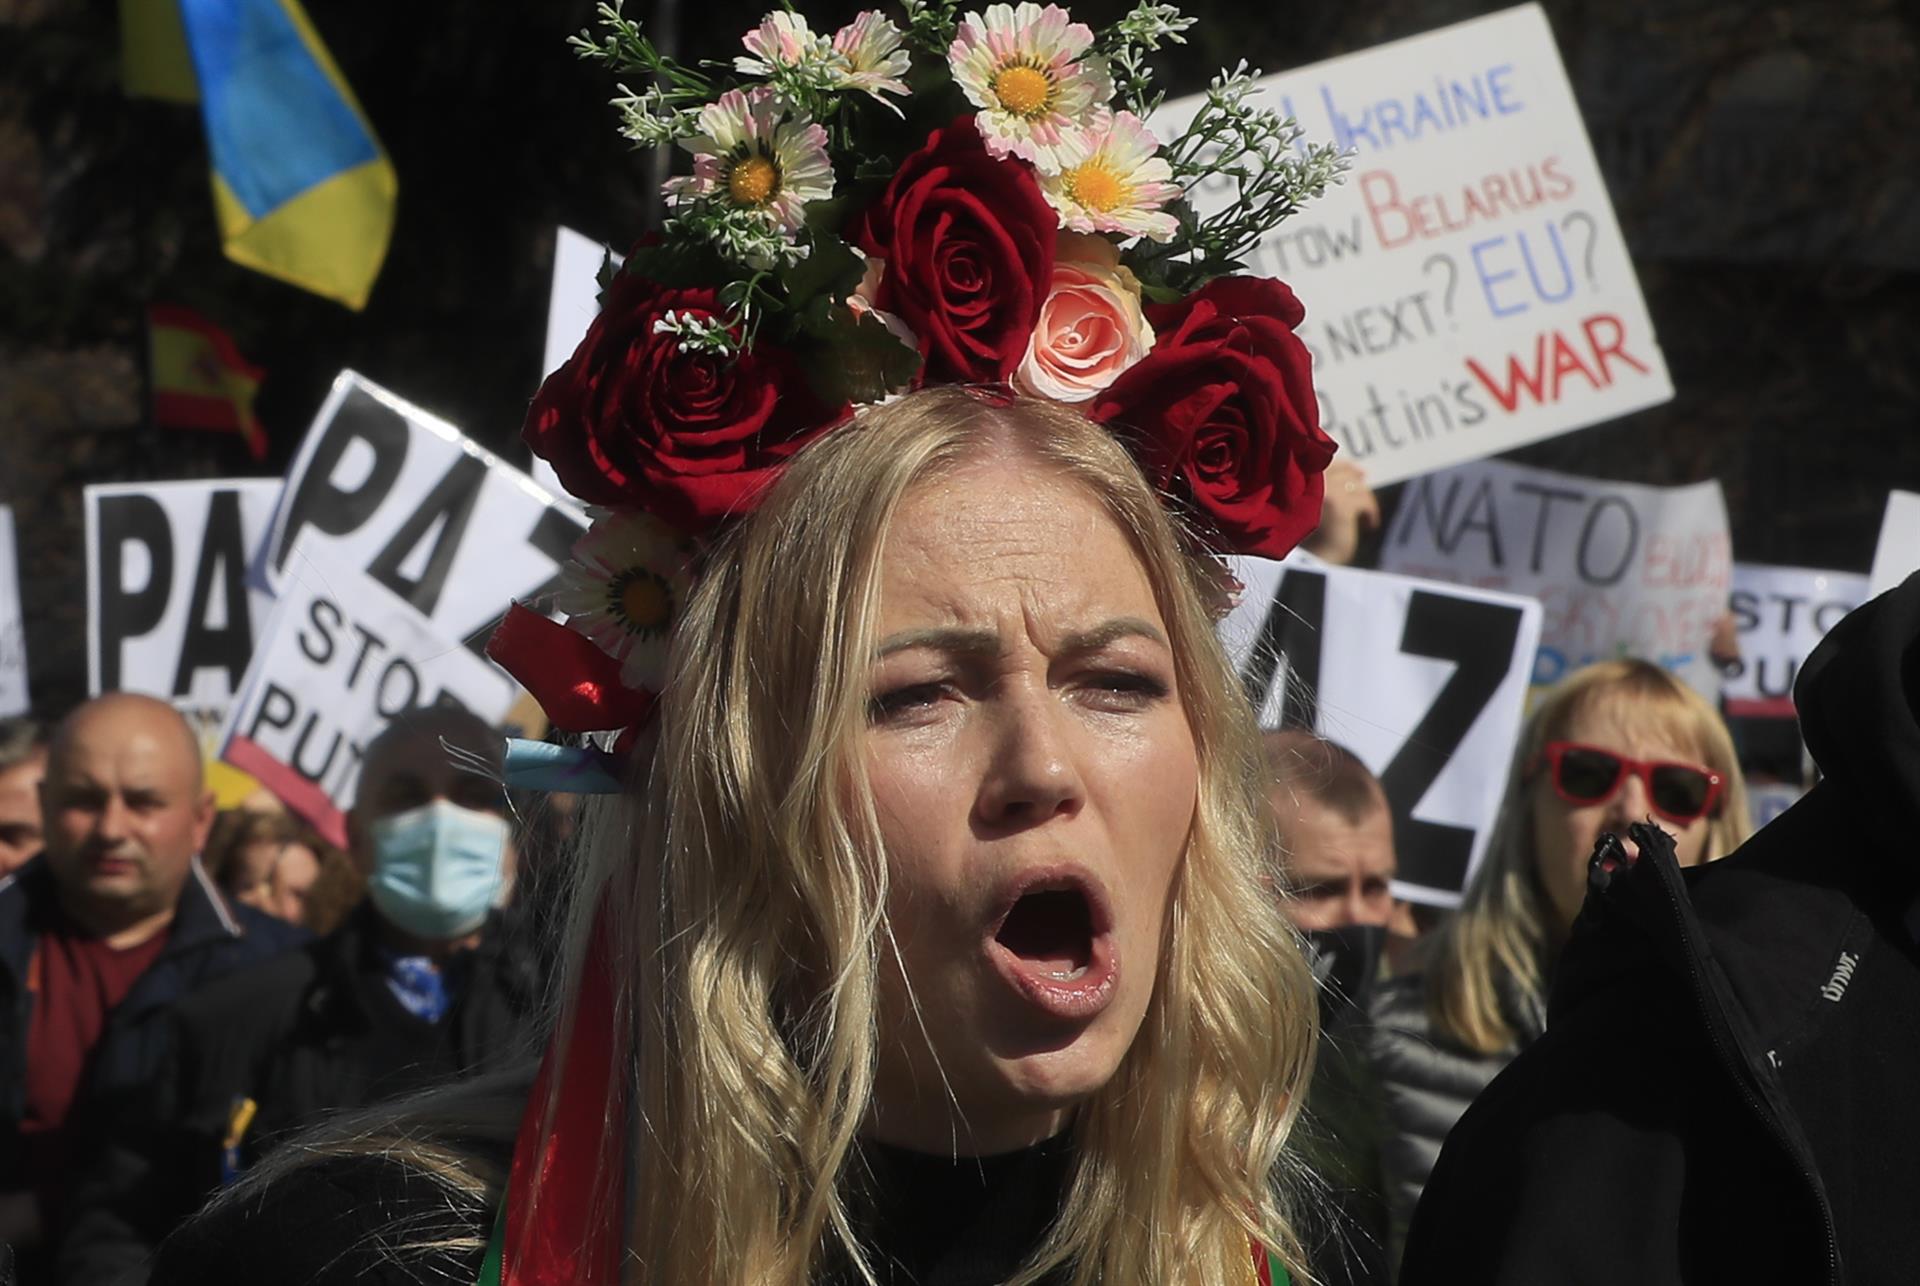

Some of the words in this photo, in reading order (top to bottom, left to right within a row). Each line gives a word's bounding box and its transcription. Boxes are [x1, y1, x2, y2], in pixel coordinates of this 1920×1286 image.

[1470, 209, 1599, 319] EU?
[1464, 312, 1652, 413] WAR
[1398, 470, 1640, 588] NATO
